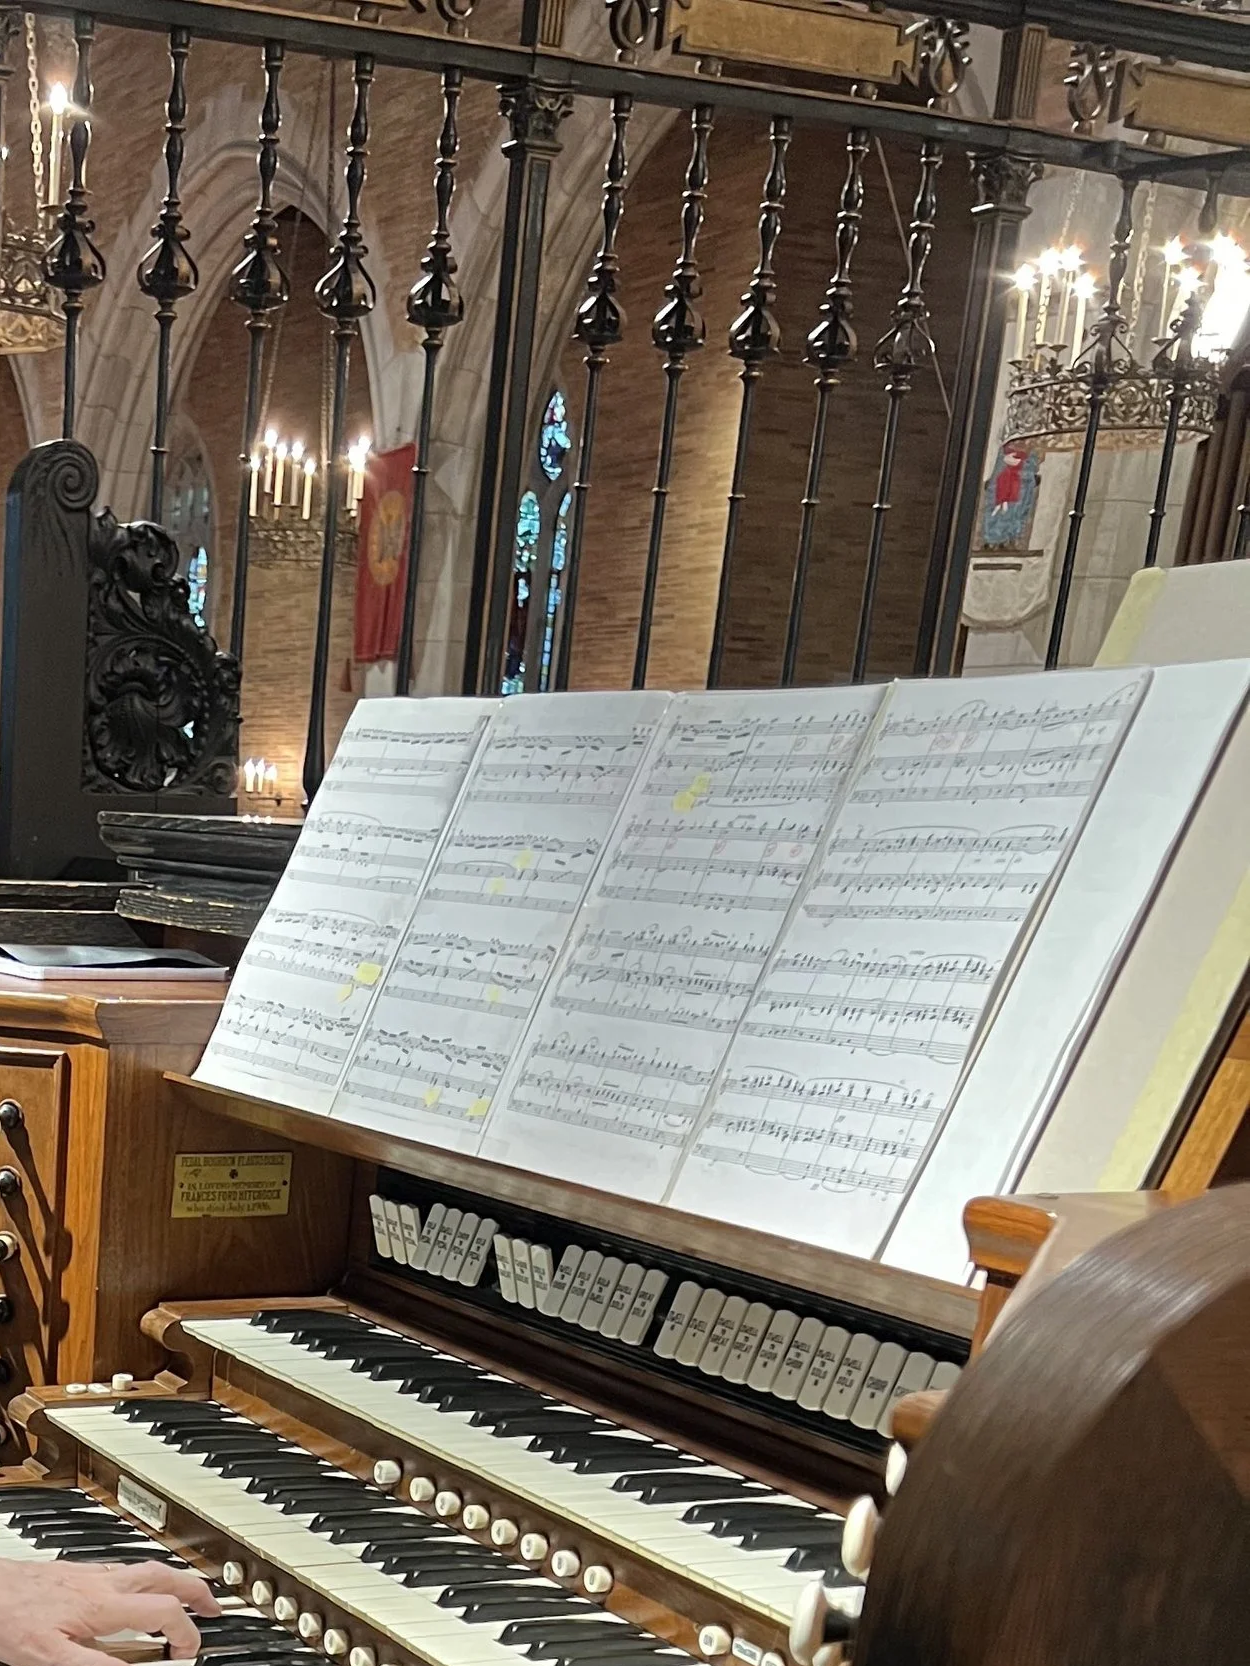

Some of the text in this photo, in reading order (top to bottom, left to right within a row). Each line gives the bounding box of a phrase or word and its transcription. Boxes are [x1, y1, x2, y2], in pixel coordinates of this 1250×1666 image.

[181, 1190, 217, 1202] FRANCES
[217, 1190, 238, 1201] FORD
[667, 1310, 686, 1326] SWELL
[689, 1317, 708, 1333] SWELL
